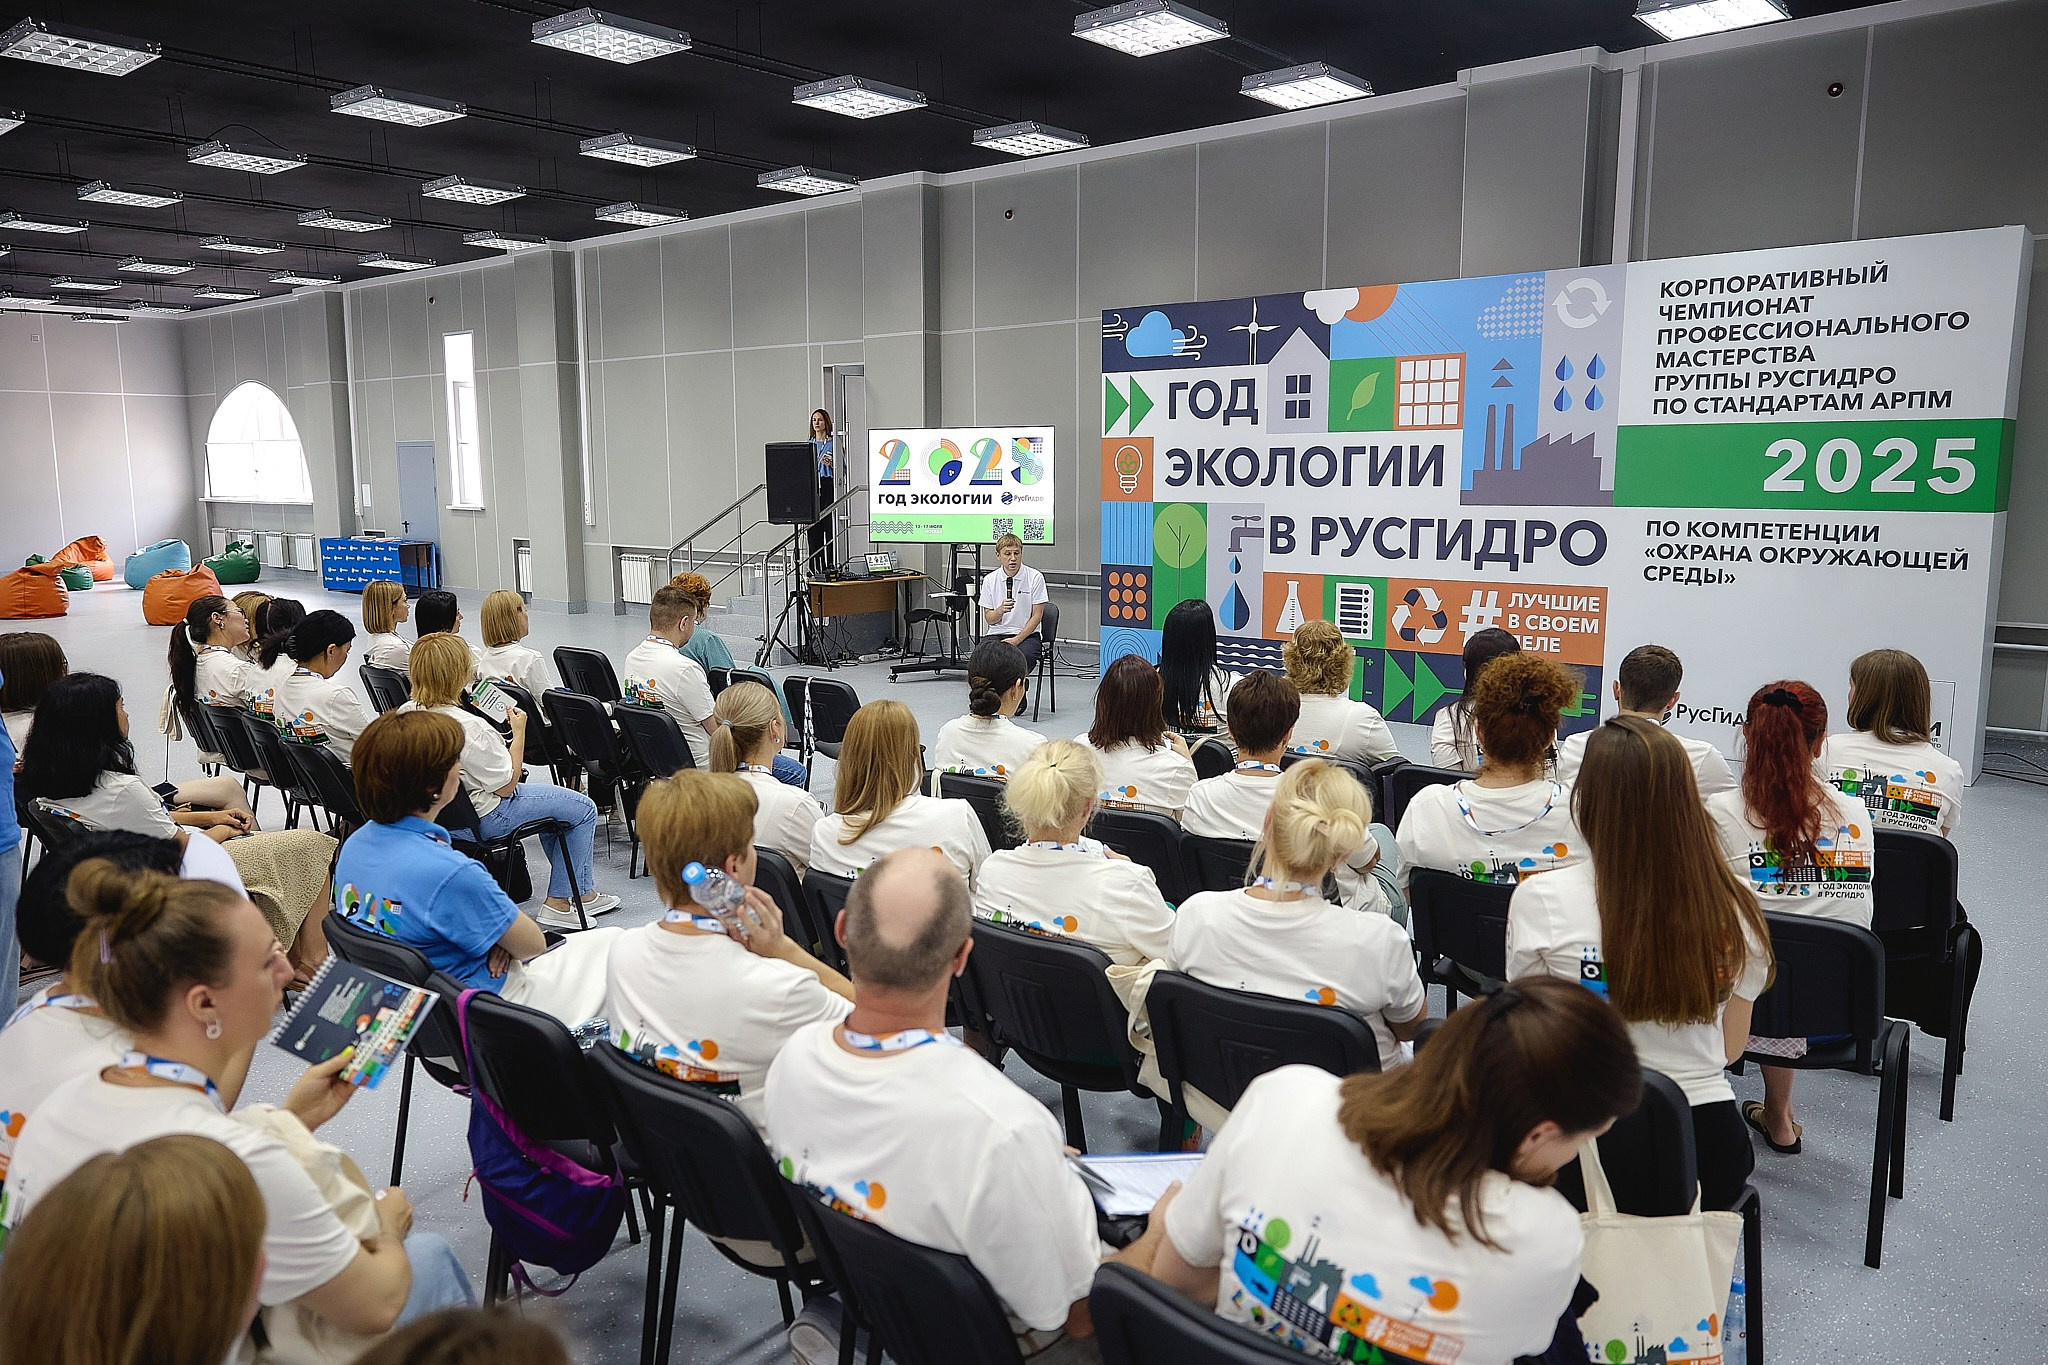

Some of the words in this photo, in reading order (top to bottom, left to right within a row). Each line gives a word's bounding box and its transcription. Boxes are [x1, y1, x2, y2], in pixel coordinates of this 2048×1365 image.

[1660, 261, 1889, 298] КОРПОРАТИВНЫЙ
[1659, 295, 1815, 322] ЧЕМПИОНАТ
[1657, 311, 1970, 346] ПРОФЕССИОНАЛЬНОГО
[1655, 345, 1816, 369] МАСТЕРСТВА
[1654, 370, 1751, 392] ГРУППЫ
[1758, 366, 1897, 390] РУСГИДРО
[1168, 377, 1259, 426] ГОД
[1653, 397, 1687, 415] ПО
[1694, 392, 1864, 416] СТАНДАРТАМ
[1870, 390, 1952, 411] АРПМ
[879, 437, 1045, 486] 2025
[1165, 444, 1445, 488] ЭКОЛОГИИ
[1763, 437, 1977, 494] 2025
[878, 494, 907, 506] ГОД
[911, 493, 993, 505] ЭКОЛОГИИ
[1269, 516, 1296, 556] В
[1310, 516, 1608, 572] РУСГИДРО
[1646, 520, 1680, 537] ПО
[1686, 521, 1880, 544] КОМПЕТЕНЦИИ
[1644, 543, 1753, 563] «ОХРАНА
[1759, 546, 1969, 572] ОКРУЖАЮЩЕЙ
[1643, 565, 1736, 586] СРЕДЫ»
[1508, 592, 1600, 613] ЛУЧШИЕ
[1508, 613, 1520, 629] В
[1525, 614, 1599, 634] СВОЕМ
[1882, 810, 1899, 819] ГОД
[1888, 818, 1928, 831] РУСГИДРО
[1825, 891, 1865, 899] РУСГИДРО
